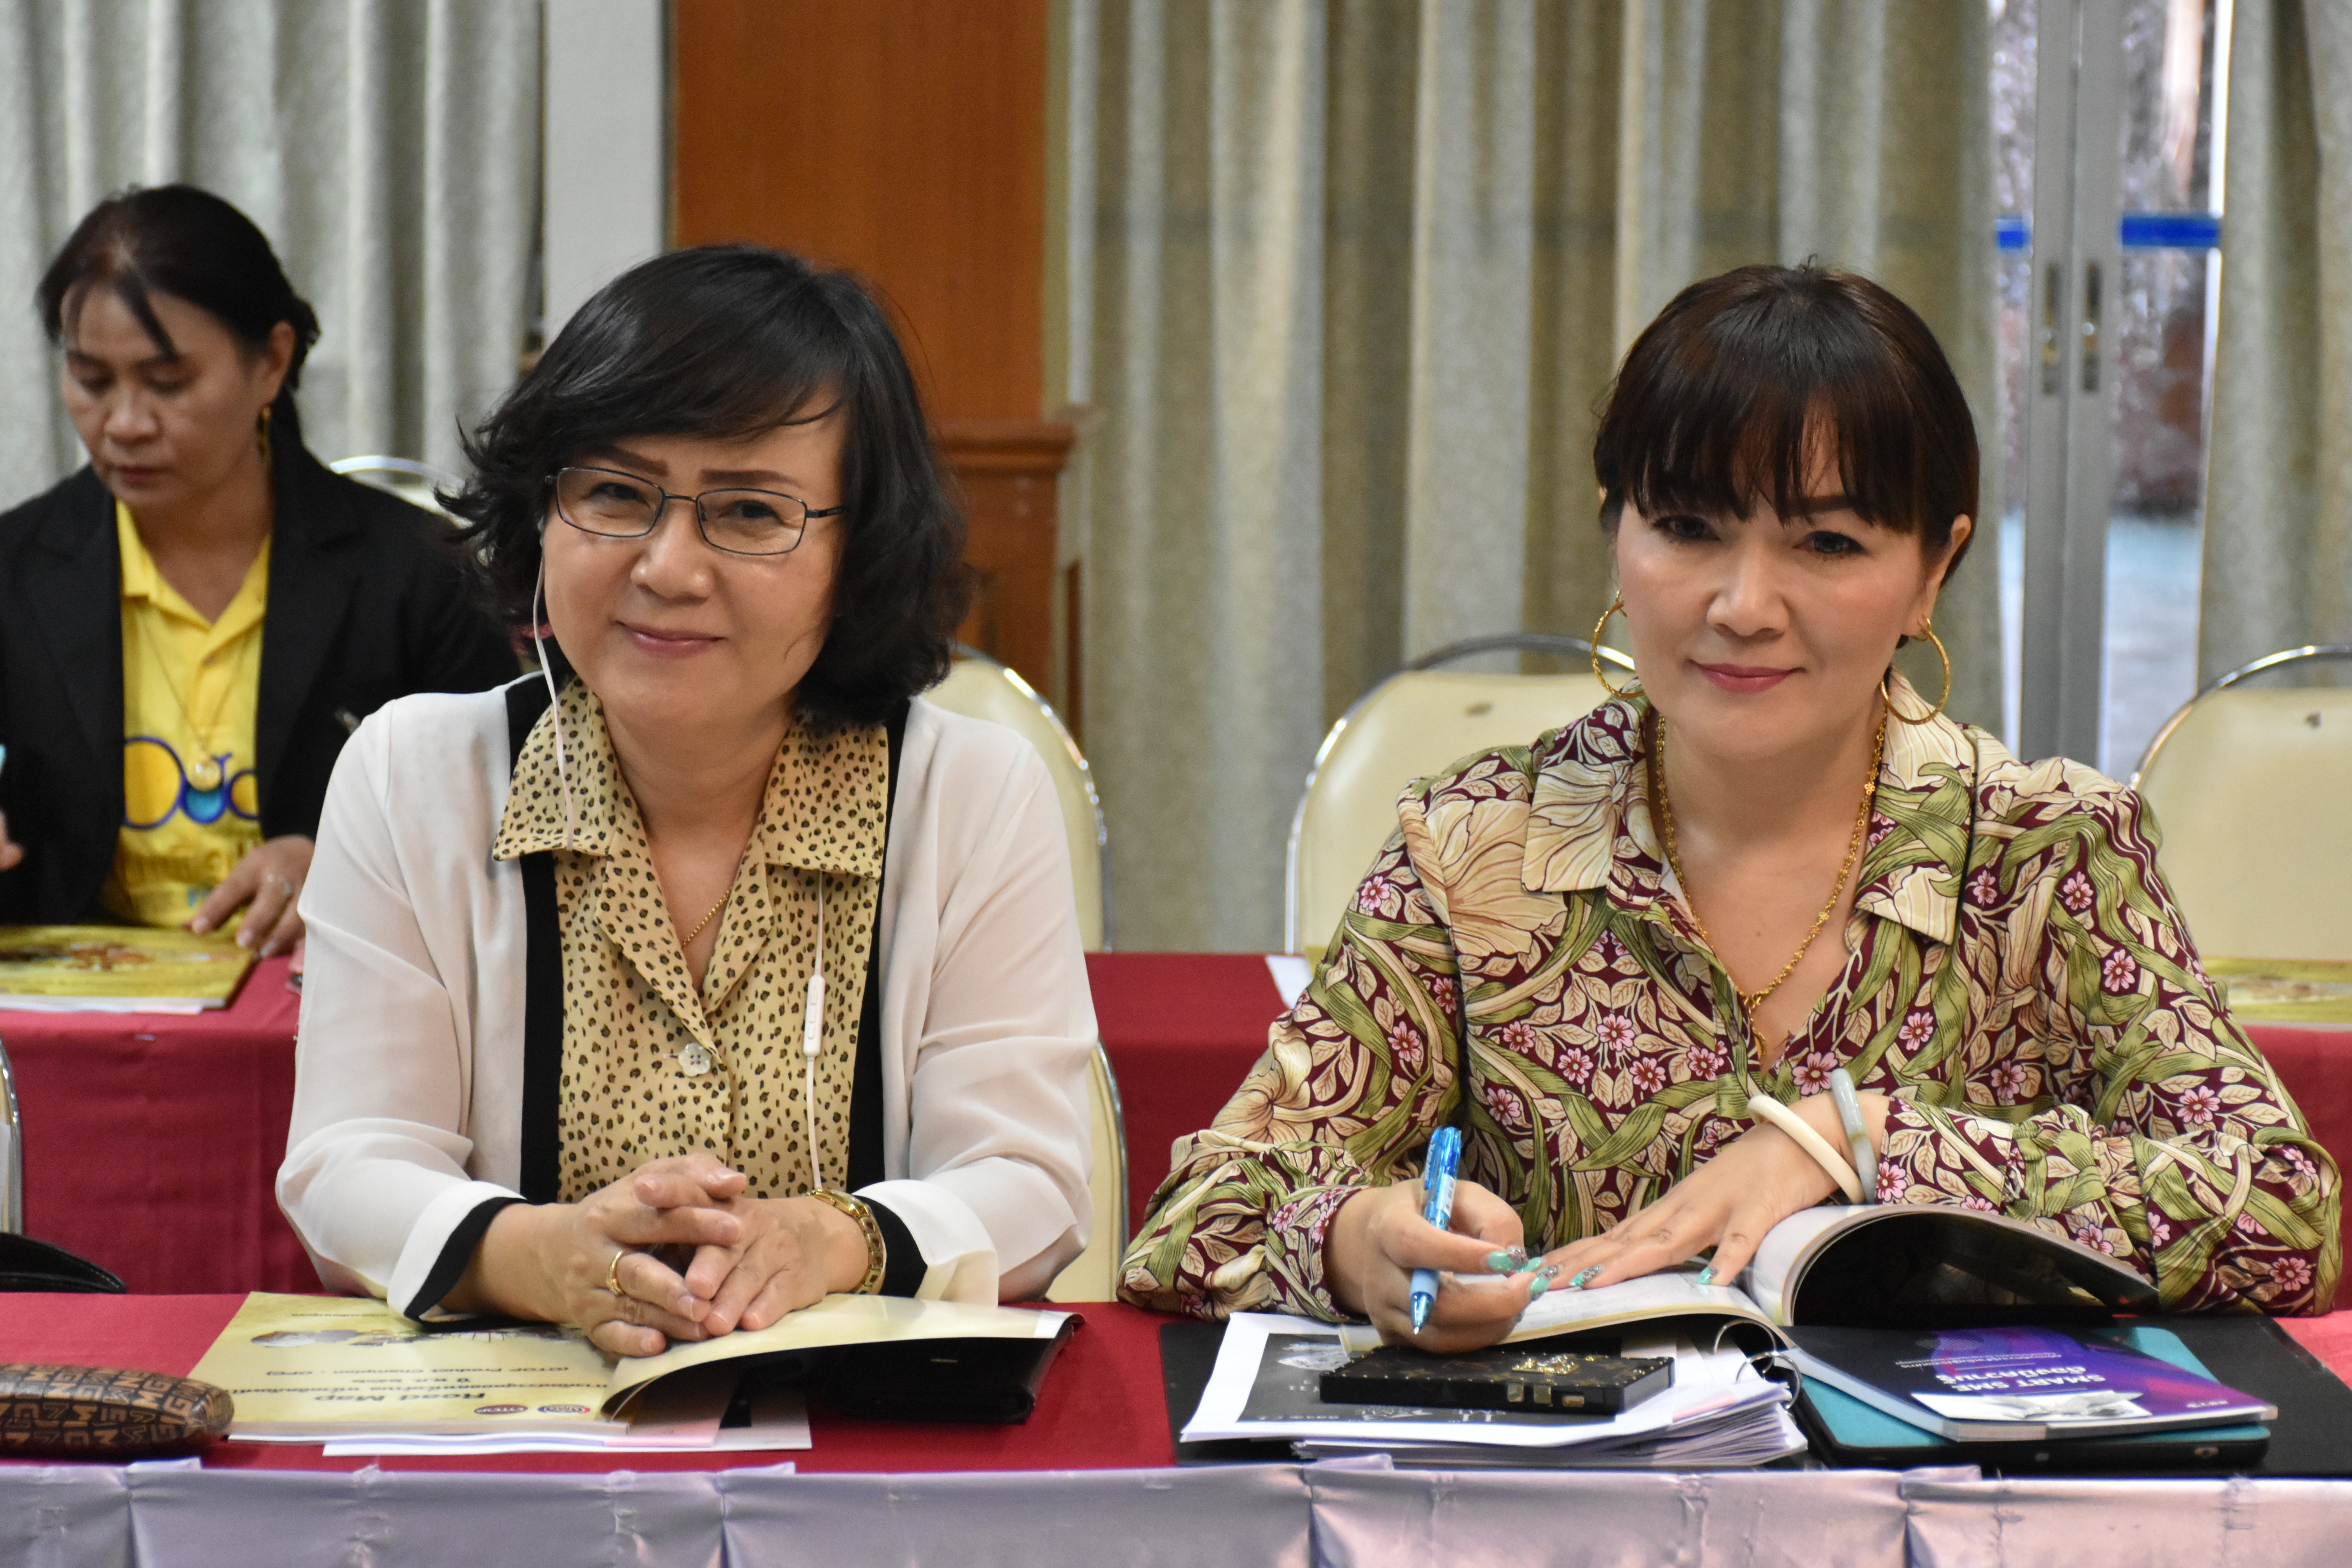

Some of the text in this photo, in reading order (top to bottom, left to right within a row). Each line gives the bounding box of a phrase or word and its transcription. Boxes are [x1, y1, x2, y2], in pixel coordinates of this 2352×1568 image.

[1952, 1374, 2105, 1392] SMART SME
[400, 1392, 485, 1401] Road
